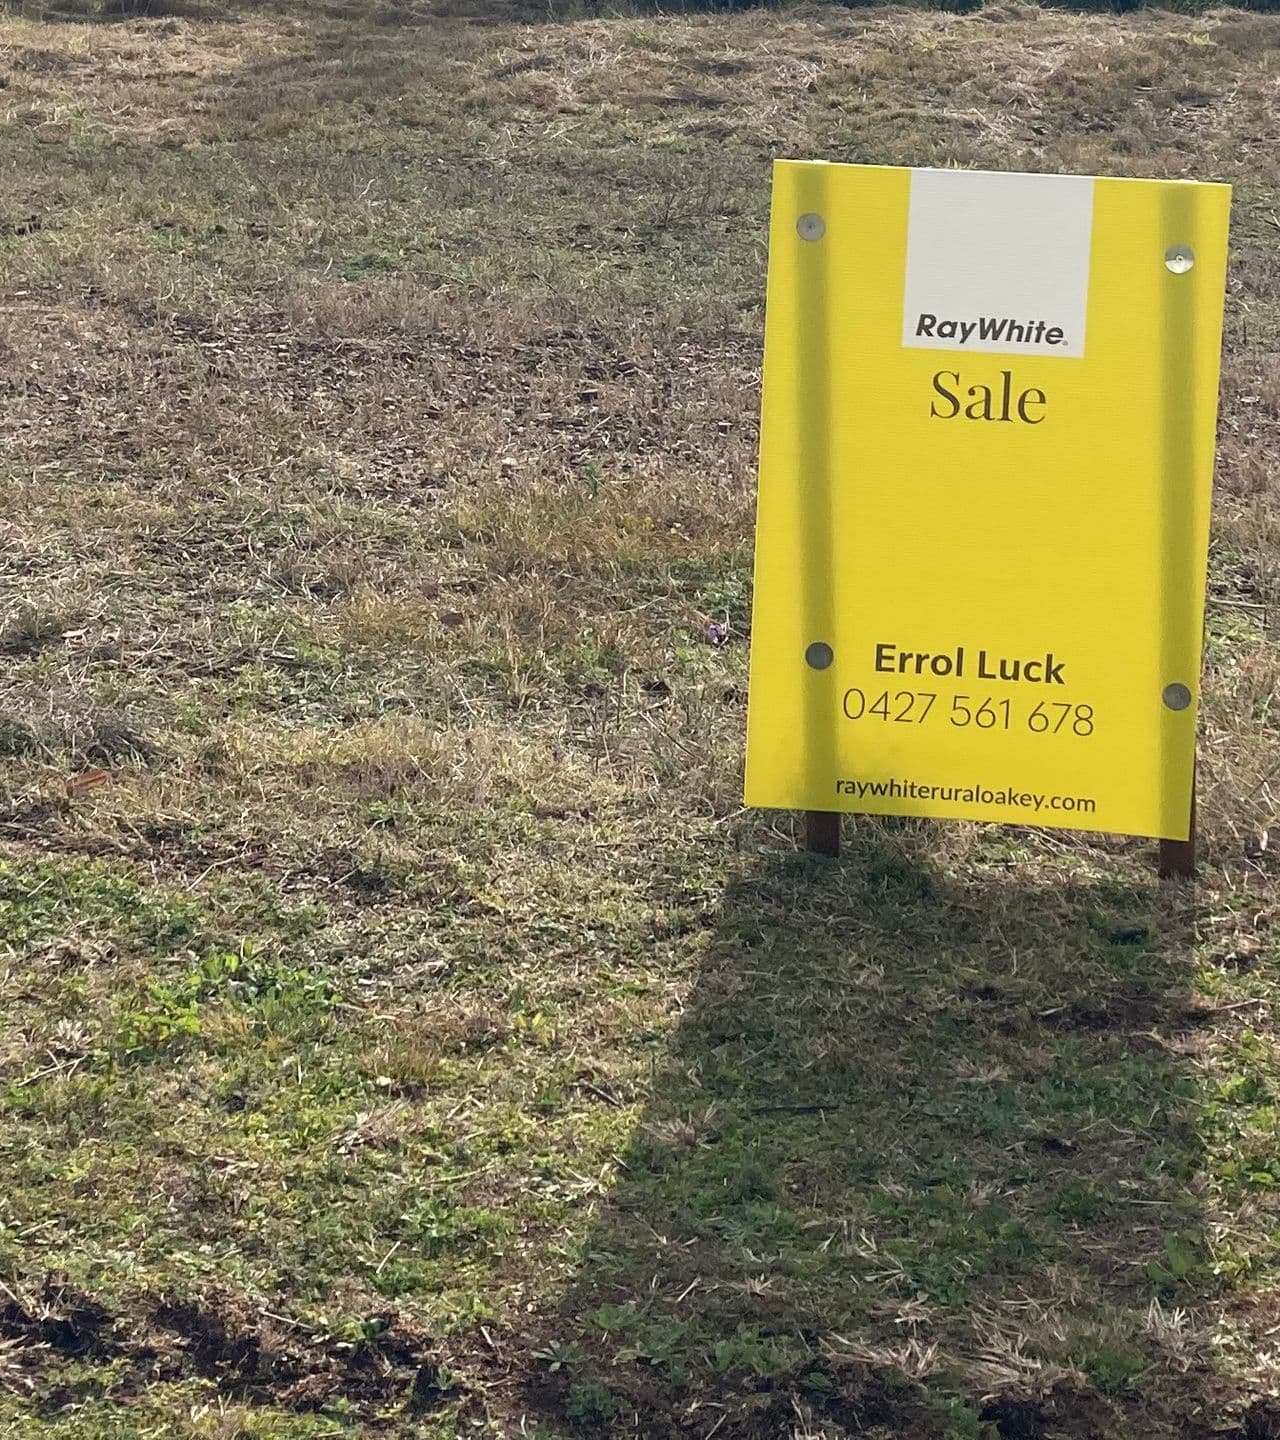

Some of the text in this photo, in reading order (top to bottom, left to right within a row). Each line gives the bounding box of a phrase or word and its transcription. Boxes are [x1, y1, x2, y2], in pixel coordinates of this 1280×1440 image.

[930, 370, 1047, 425] Sale
[874, 643, 1066, 685] Errol Luck
[843, 687, 1095, 737] 0427 561 678
[836, 778, 1096, 813] raywhiteruraloakey.com
